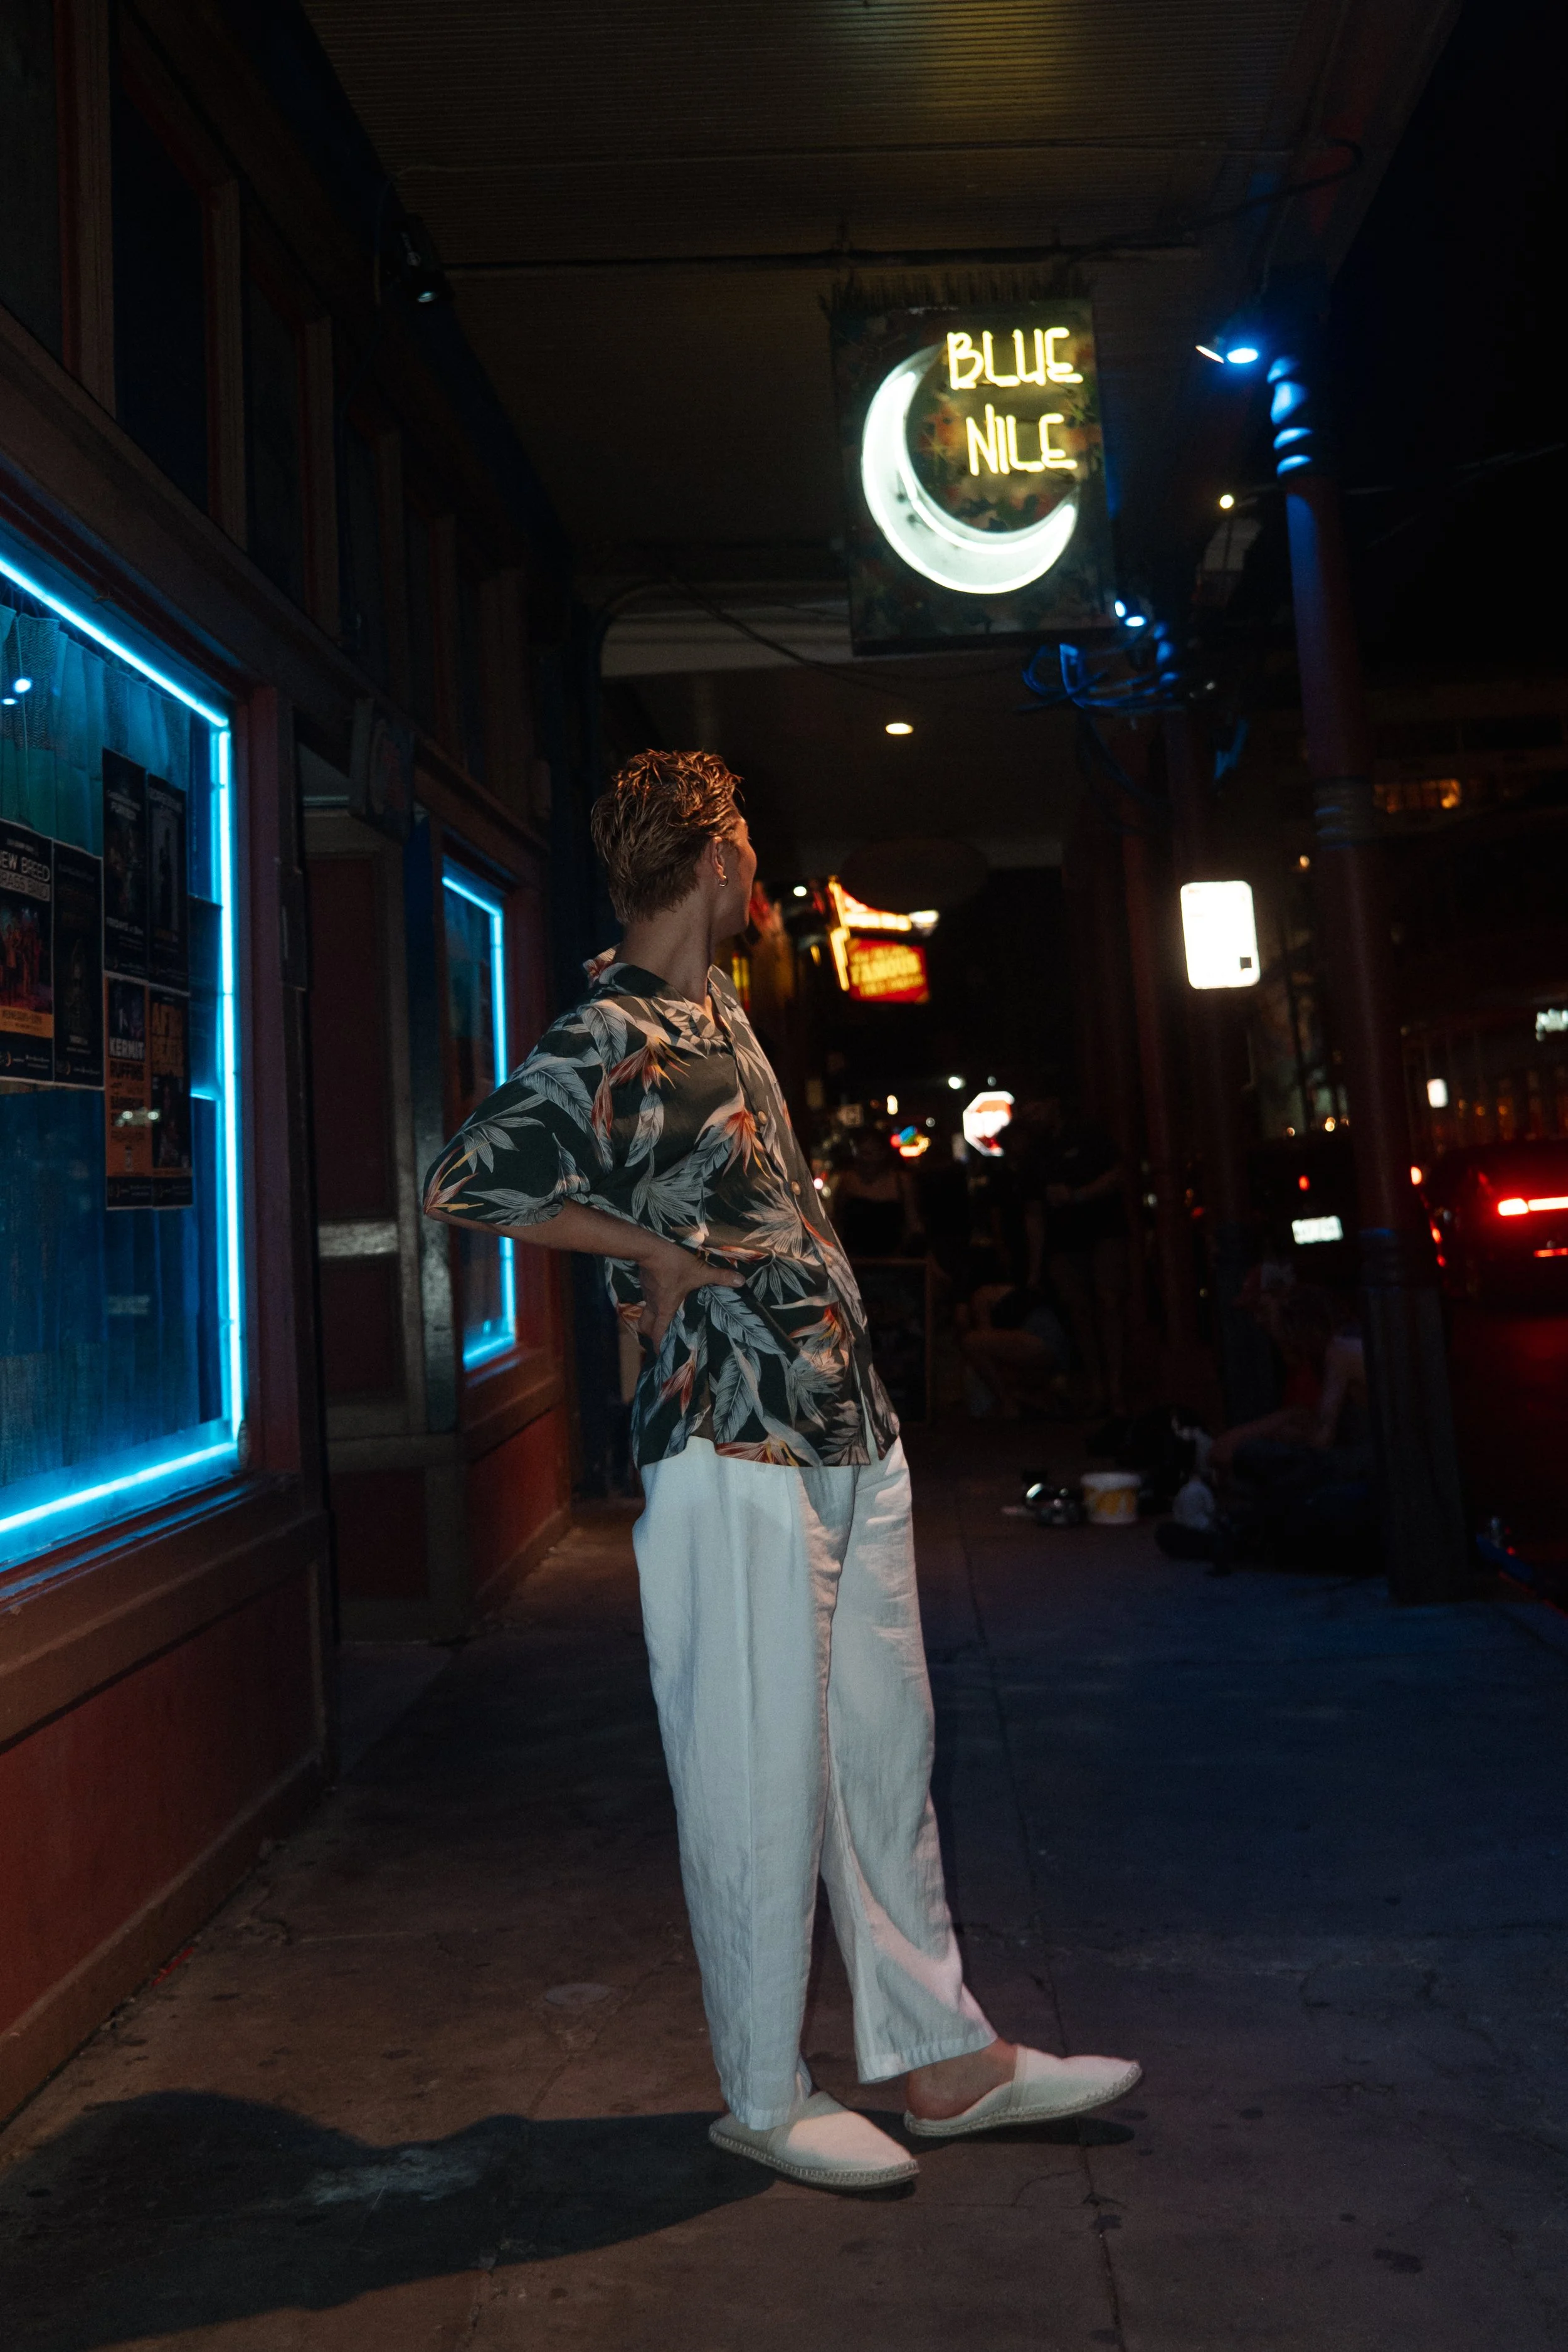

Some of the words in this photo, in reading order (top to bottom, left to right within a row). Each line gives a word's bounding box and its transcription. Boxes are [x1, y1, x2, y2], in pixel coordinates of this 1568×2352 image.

[946, 327, 1083, 390] BLUE
[965, 403, 1078, 476] NILE
[21, 856, 50, 882] BREED
